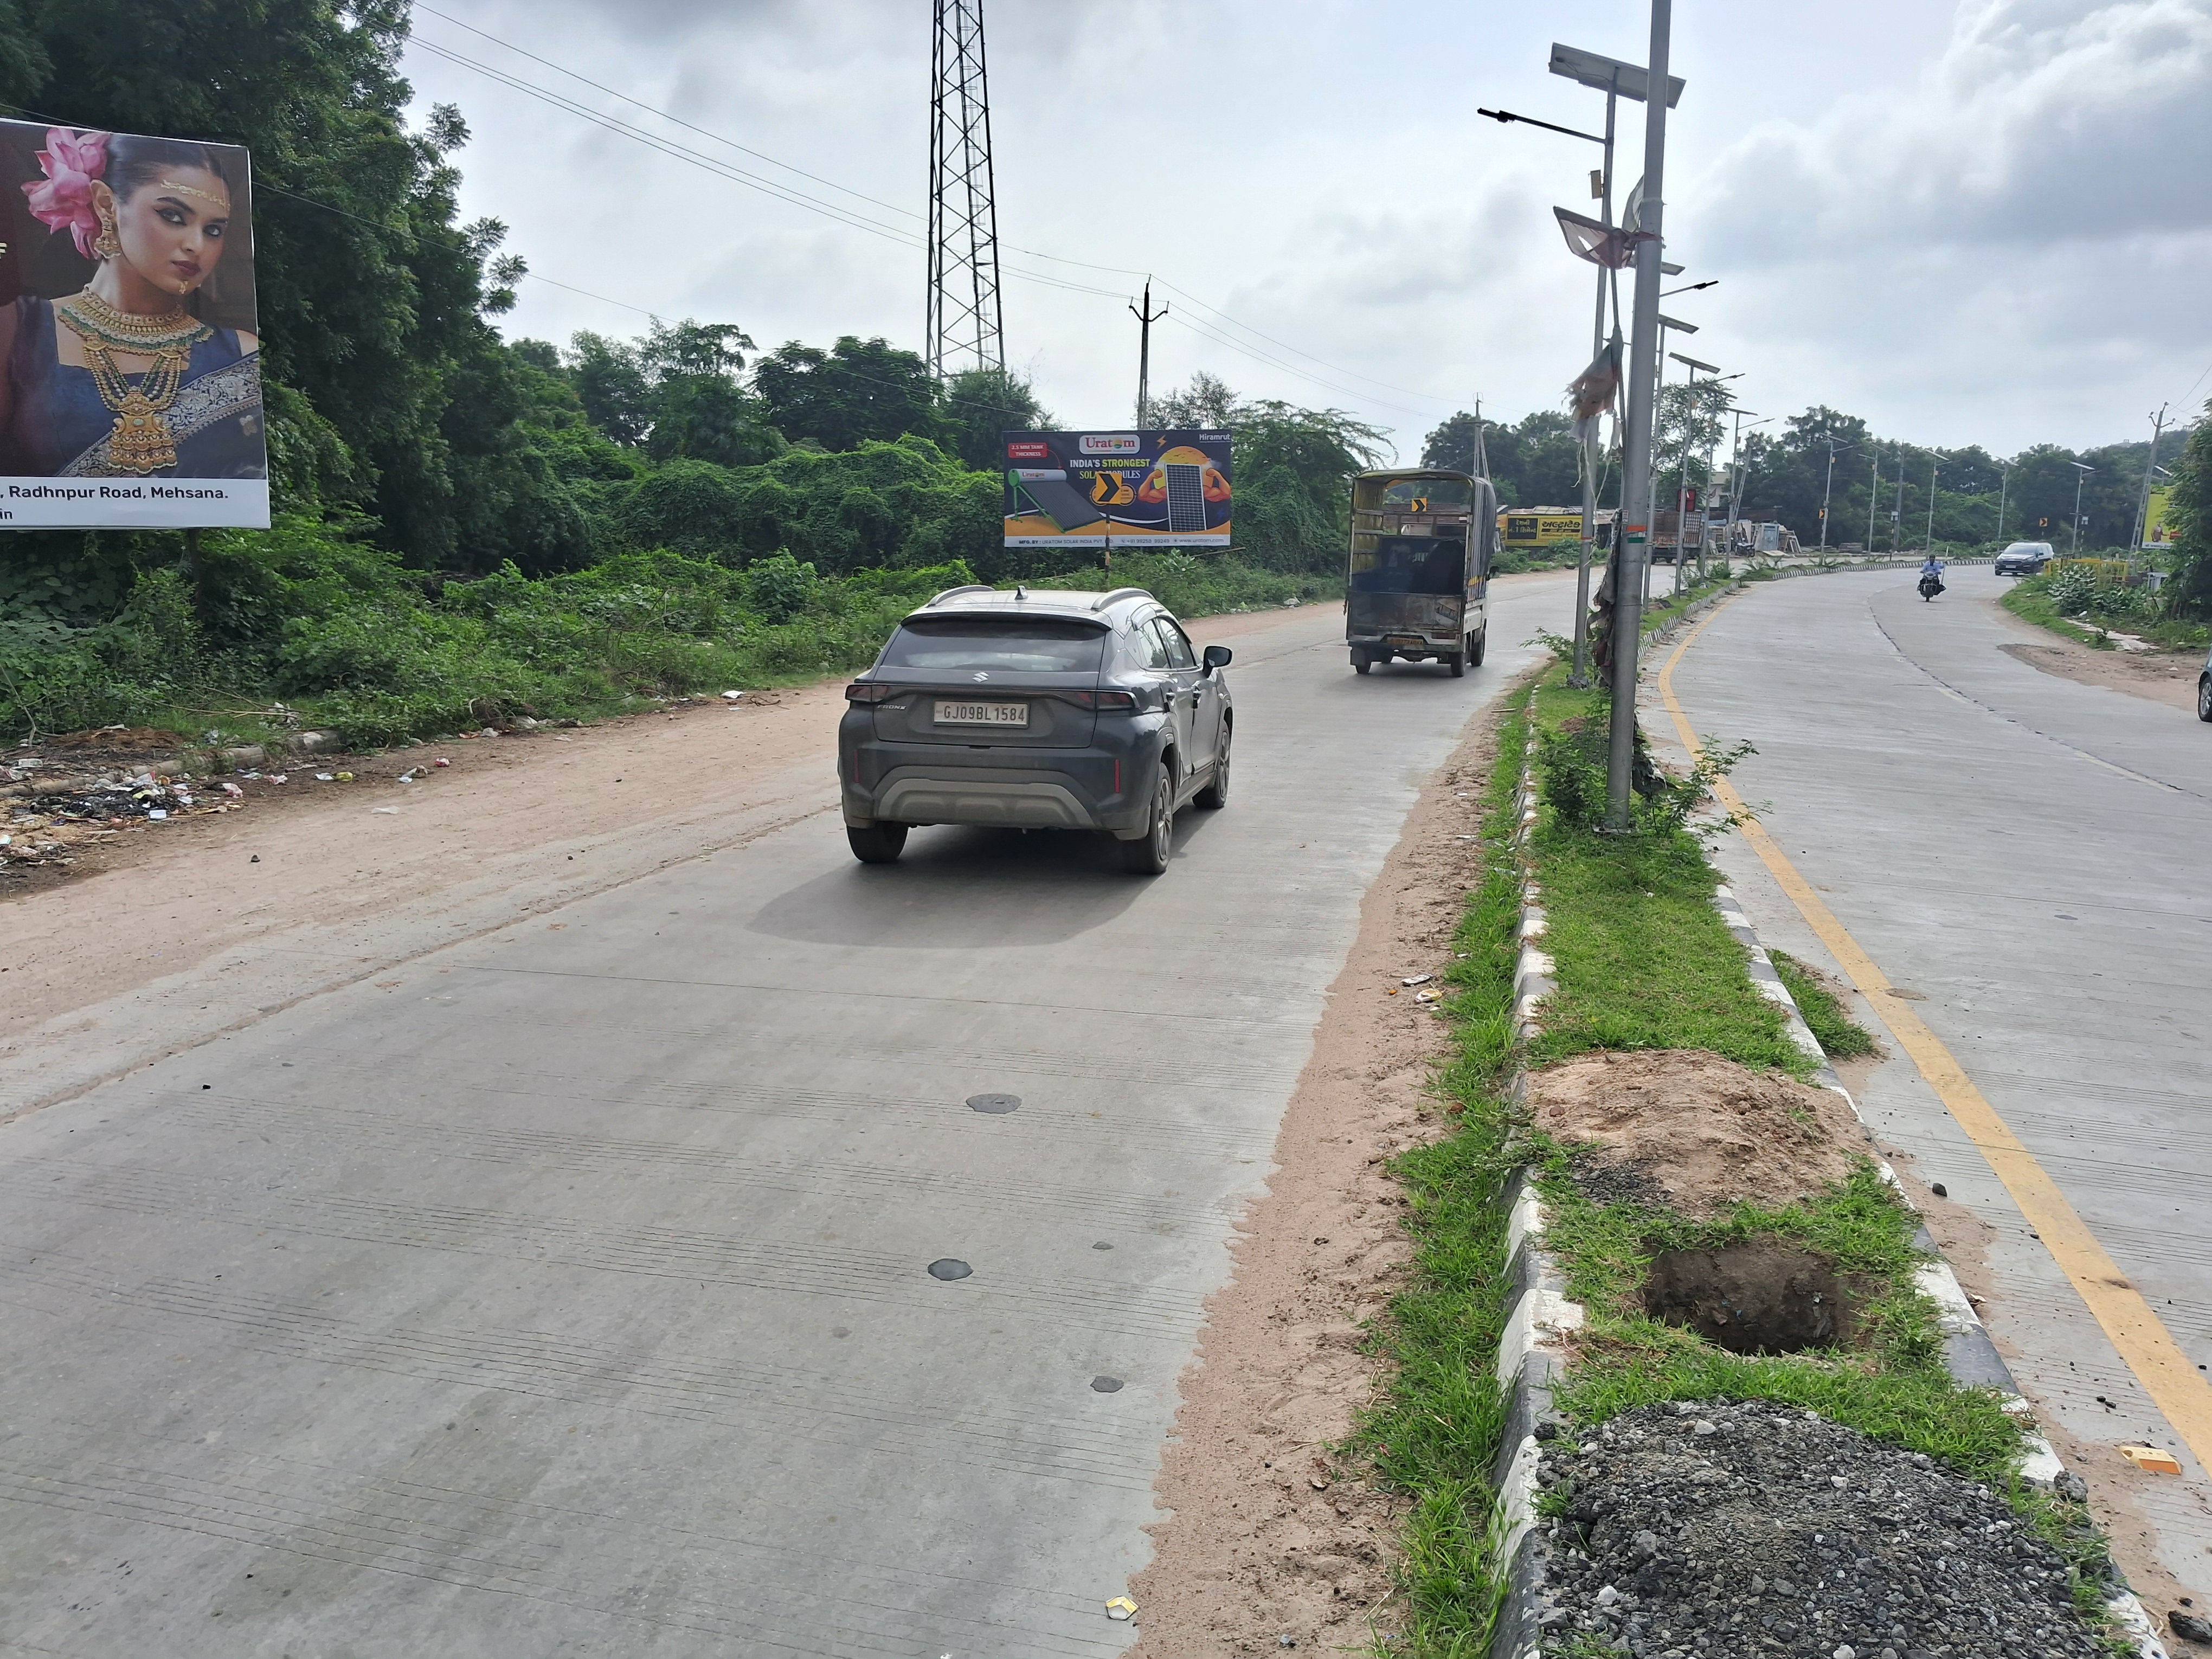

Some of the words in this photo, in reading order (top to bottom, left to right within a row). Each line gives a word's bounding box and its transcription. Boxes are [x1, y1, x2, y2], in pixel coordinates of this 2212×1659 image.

[1070, 459, 1100, 467] INDIA'S
[1102, 459, 1150, 467] STRONGEST
[9, 486, 95, 501] Radhnpur
[100, 486, 146, 499] Road,
[151, 487, 228, 499] Mehsana.
